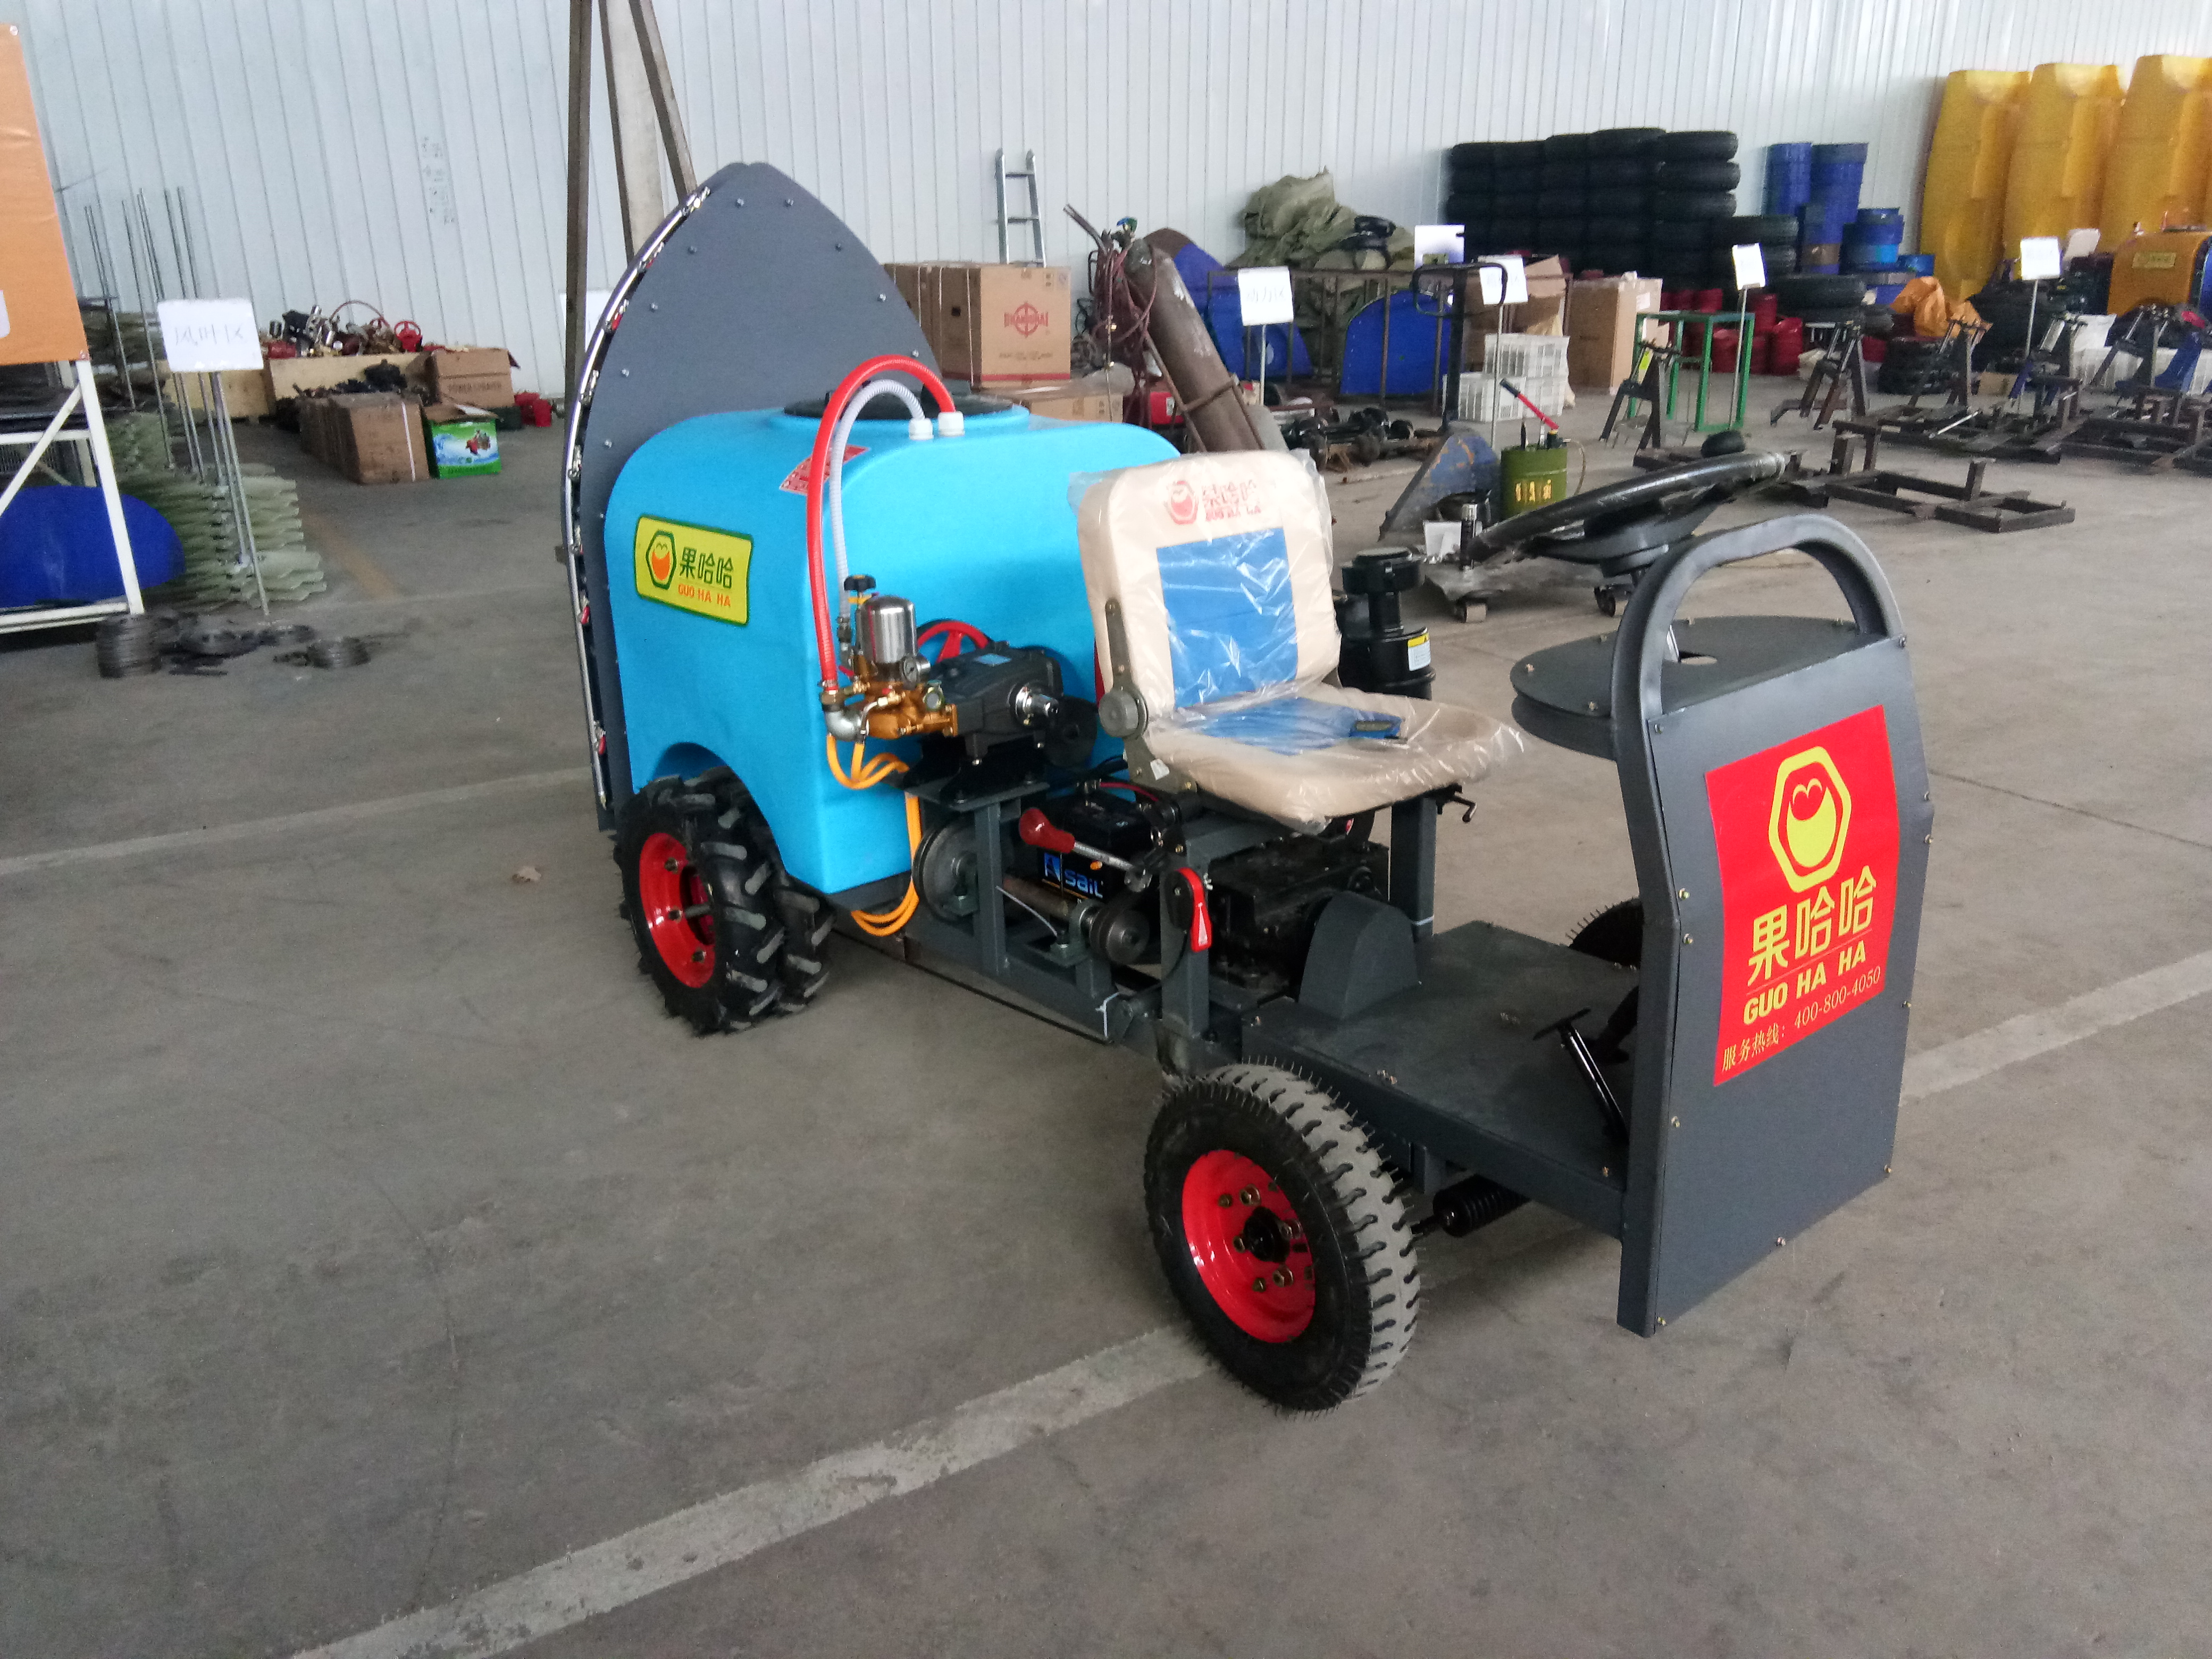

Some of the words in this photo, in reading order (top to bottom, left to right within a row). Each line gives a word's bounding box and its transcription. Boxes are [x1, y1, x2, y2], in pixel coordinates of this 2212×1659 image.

[678, 583, 695, 598] GUO
[698, 588, 712, 603] HA
[716, 593, 731, 607] HA
[679, 546, 734, 589] 果哈哈
[1747, 865, 1877, 986] 果哈哈
[1743, 981, 1789, 1025] GUO
[1796, 961, 1827, 1000] HA
[1838, 940, 1866, 976] HA
[1795, 965, 1881, 1029] 400-800-4050
